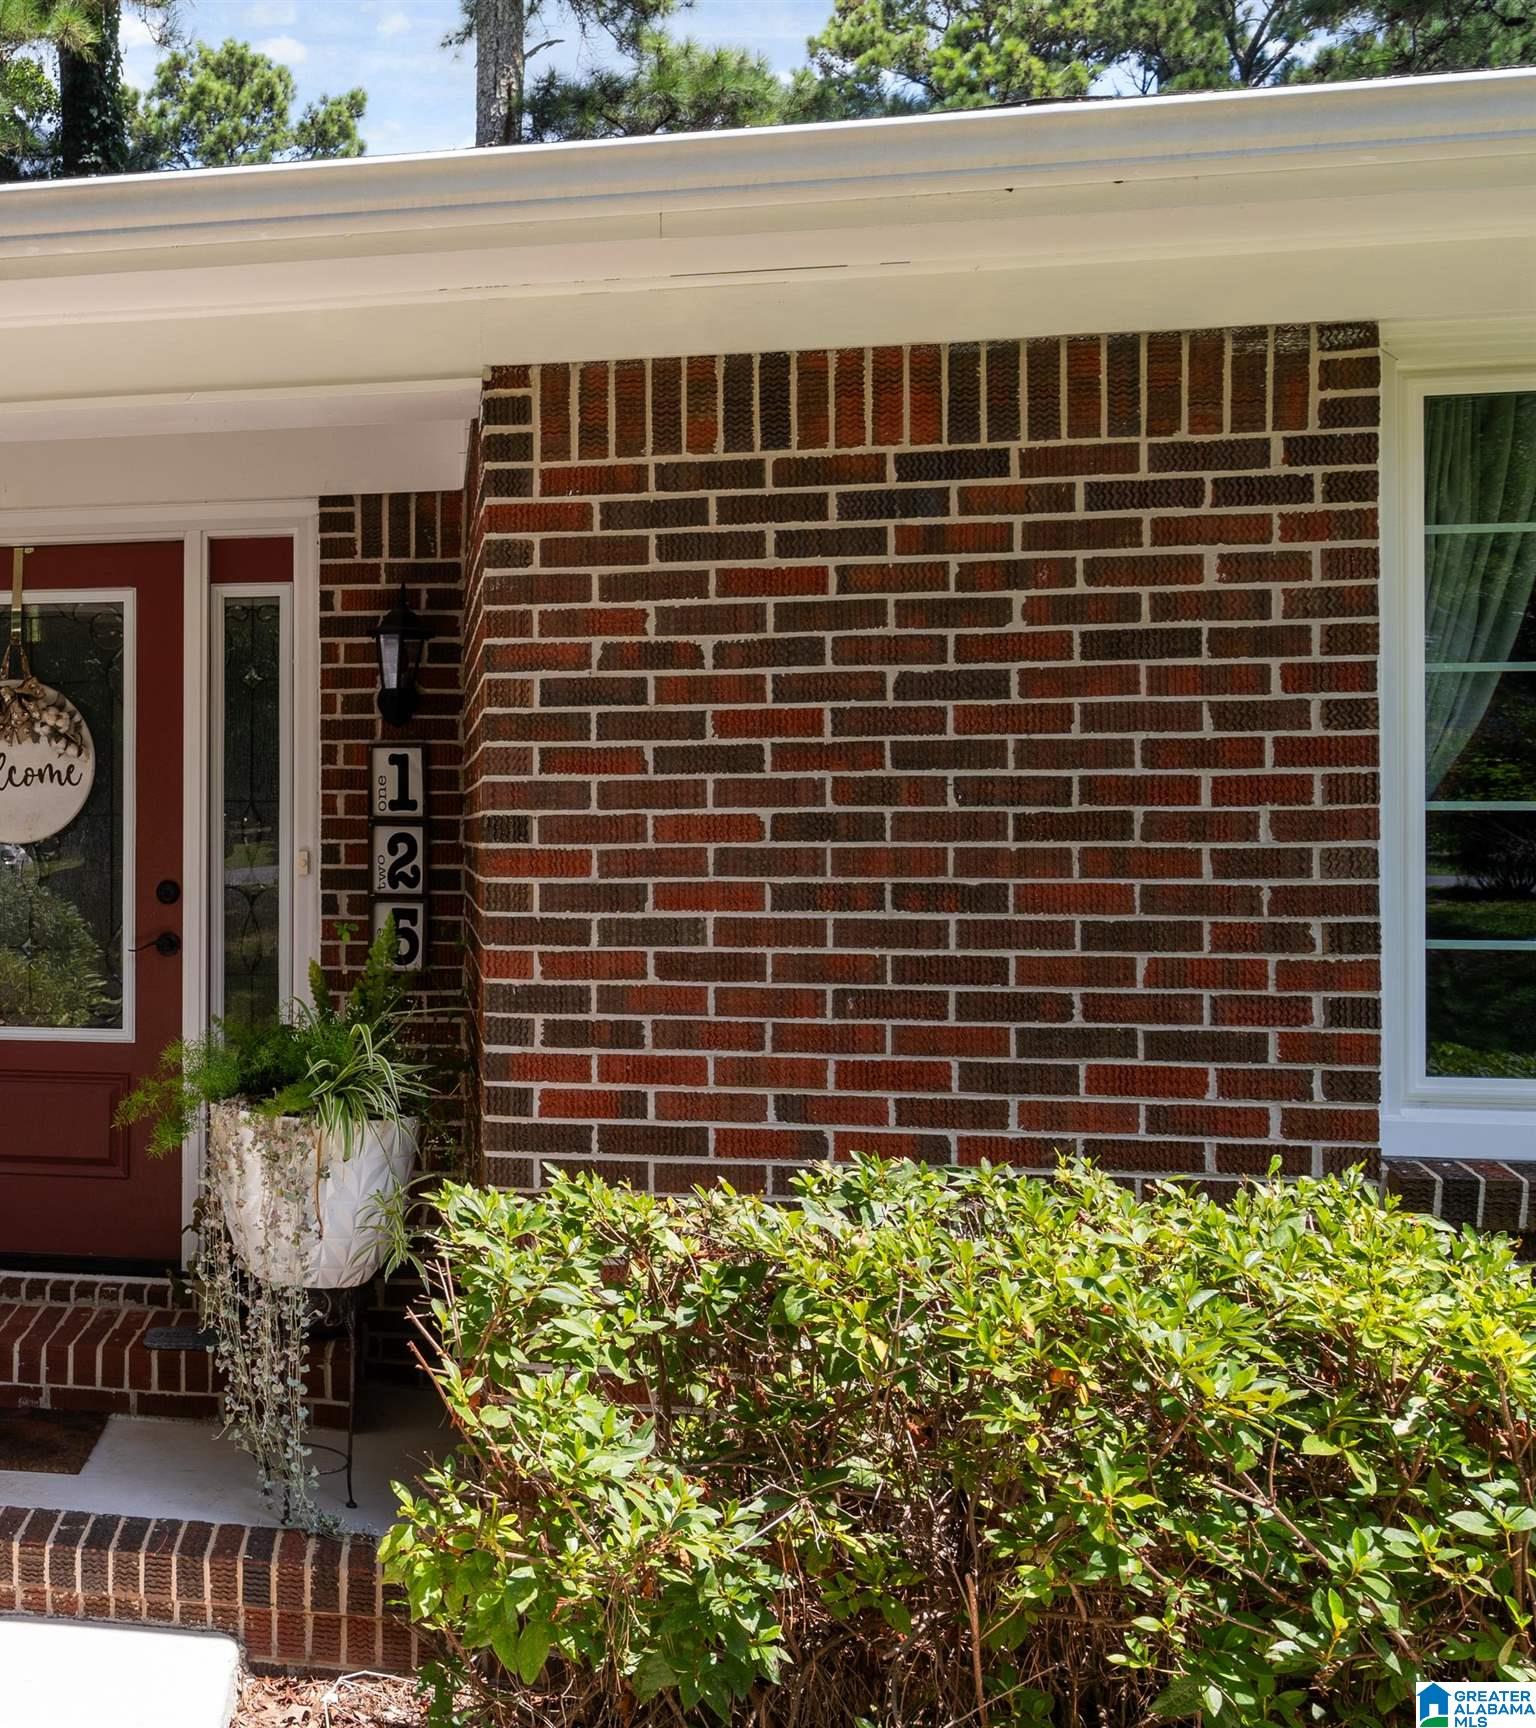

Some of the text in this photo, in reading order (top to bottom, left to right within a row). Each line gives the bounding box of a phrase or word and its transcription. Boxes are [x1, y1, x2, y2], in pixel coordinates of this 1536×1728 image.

[377, 774, 387, 812] one
[388, 753, 418, 812] 1
[377, 854, 386, 890] two
[387, 832, 421, 890] 2
